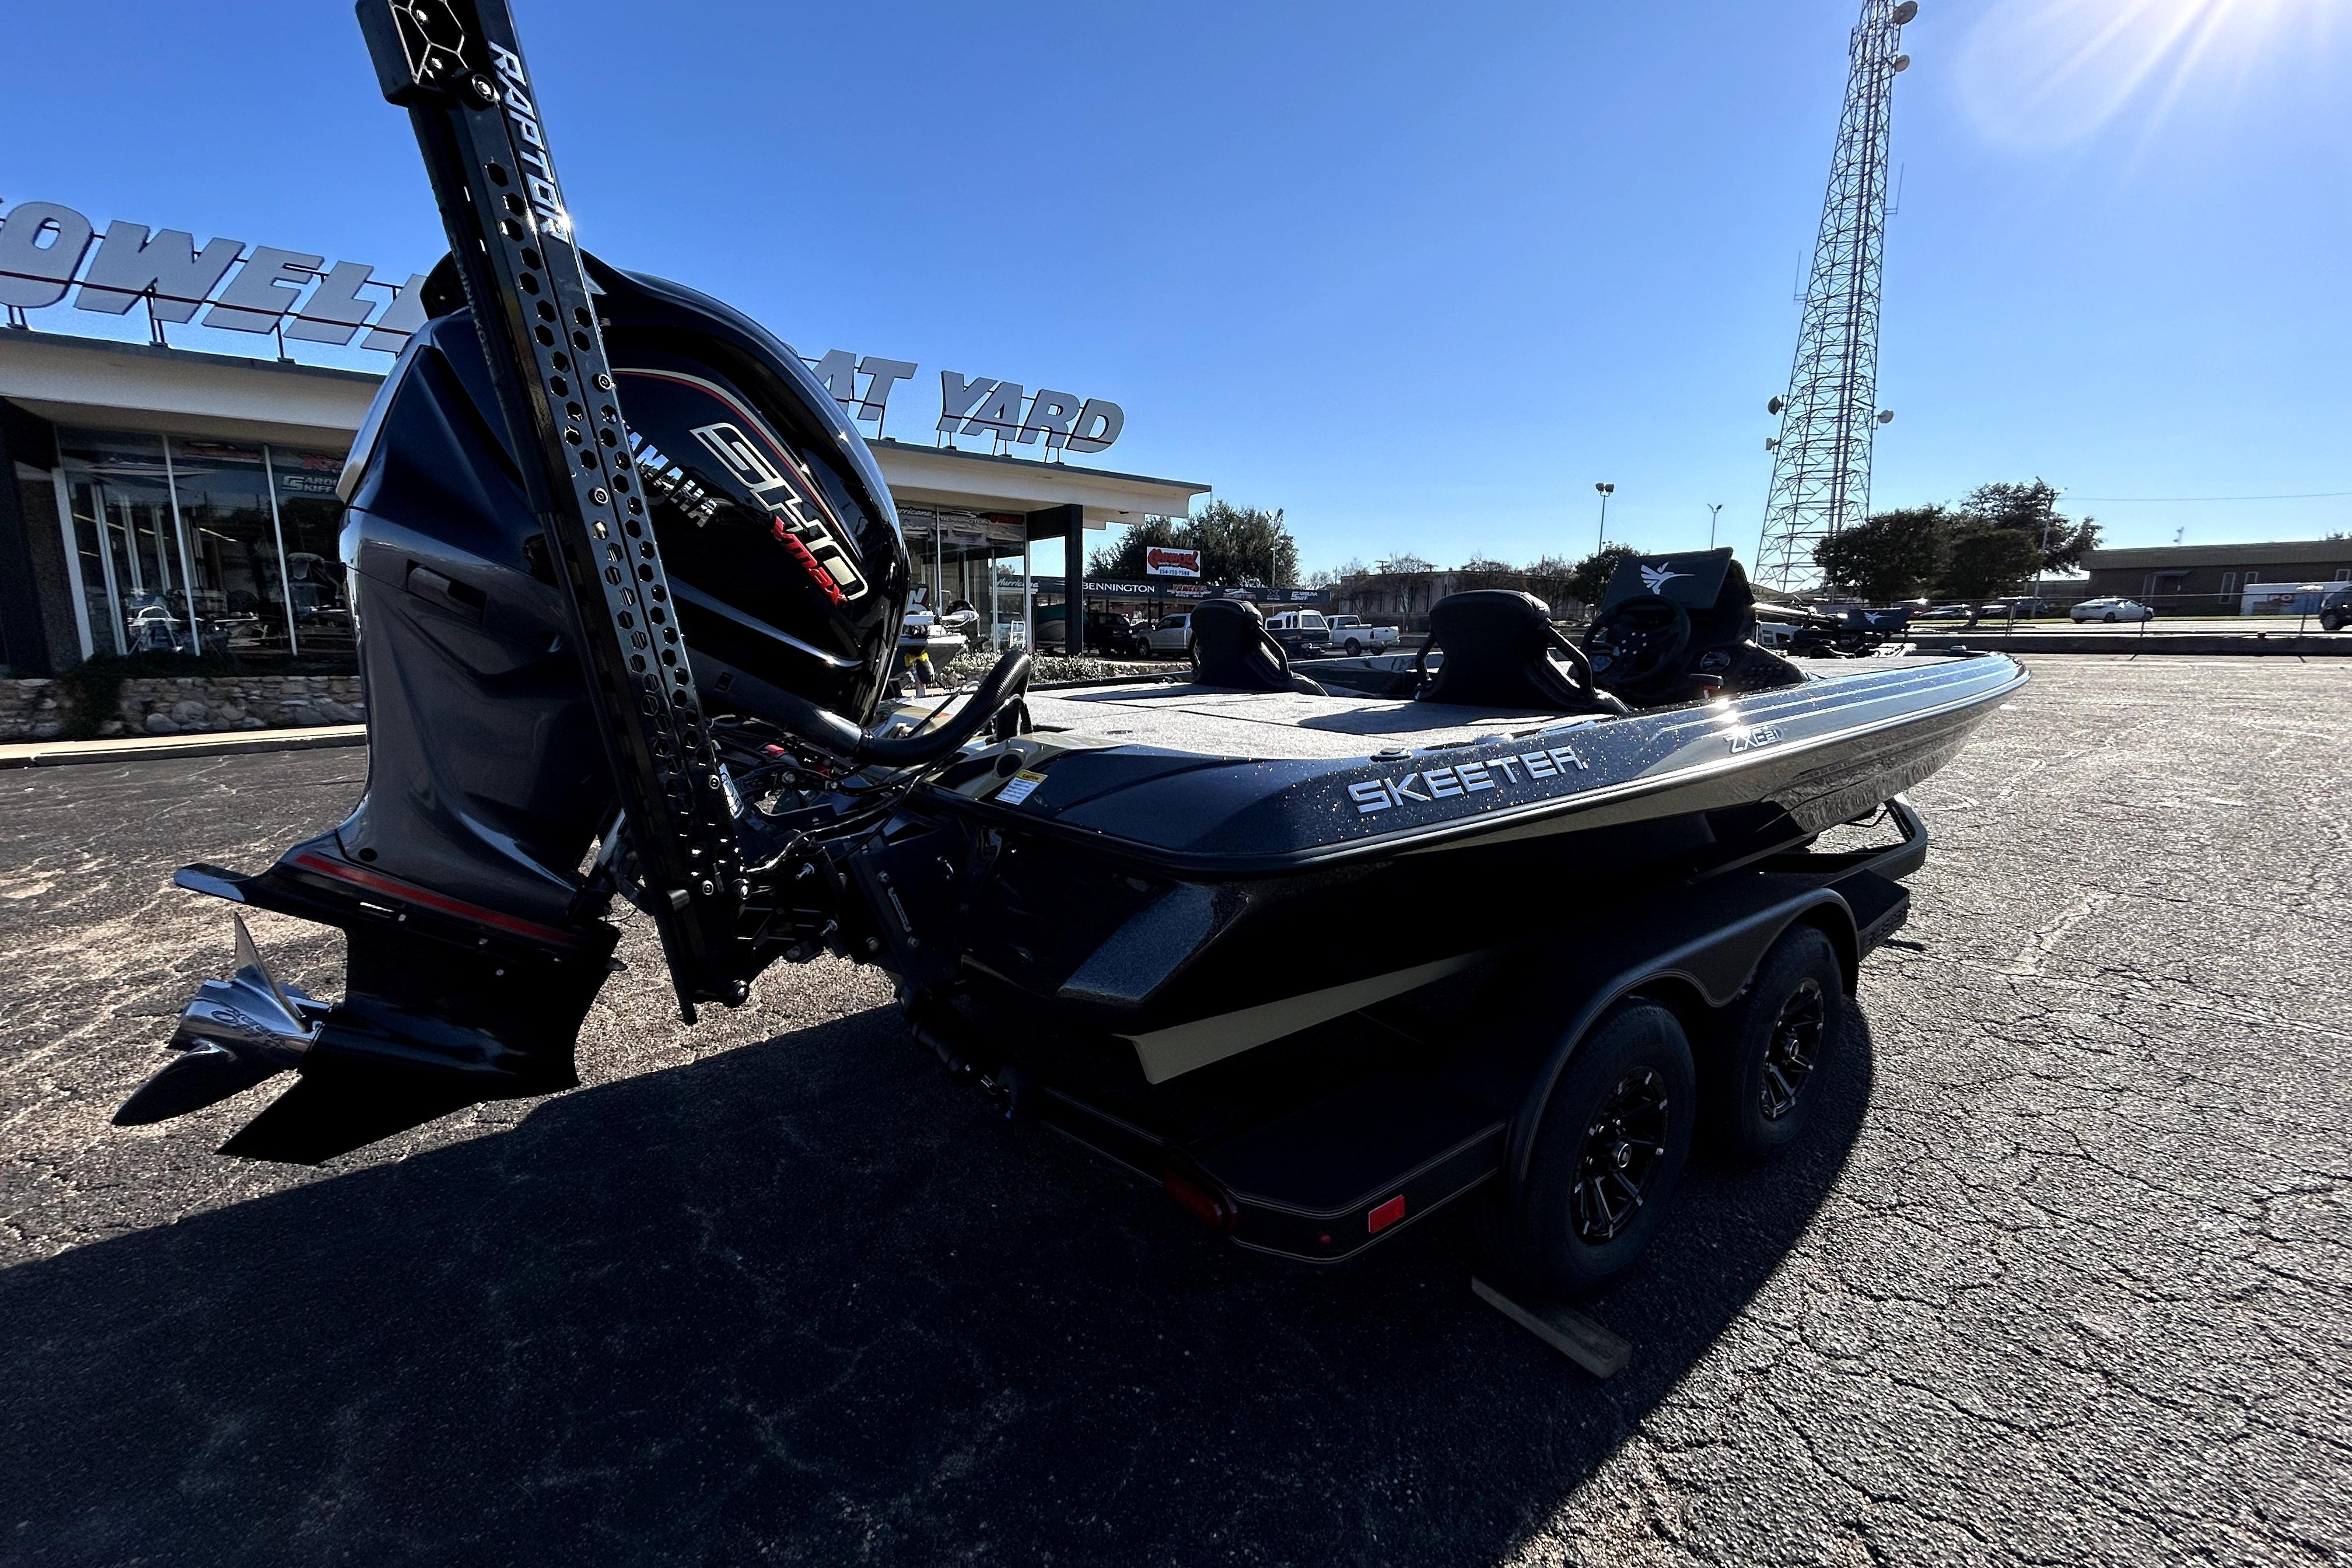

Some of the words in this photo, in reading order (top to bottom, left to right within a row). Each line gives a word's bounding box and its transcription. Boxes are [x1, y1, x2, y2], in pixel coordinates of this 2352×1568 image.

[488, 40, 572, 244] RAPTOR
[935, 370, 1125, 453] YARD
[896, 507, 933, 517] urricane
[1083, 582, 1155, 593] BENNINGTON
[1347, 745, 1588, 814] SKEETER
